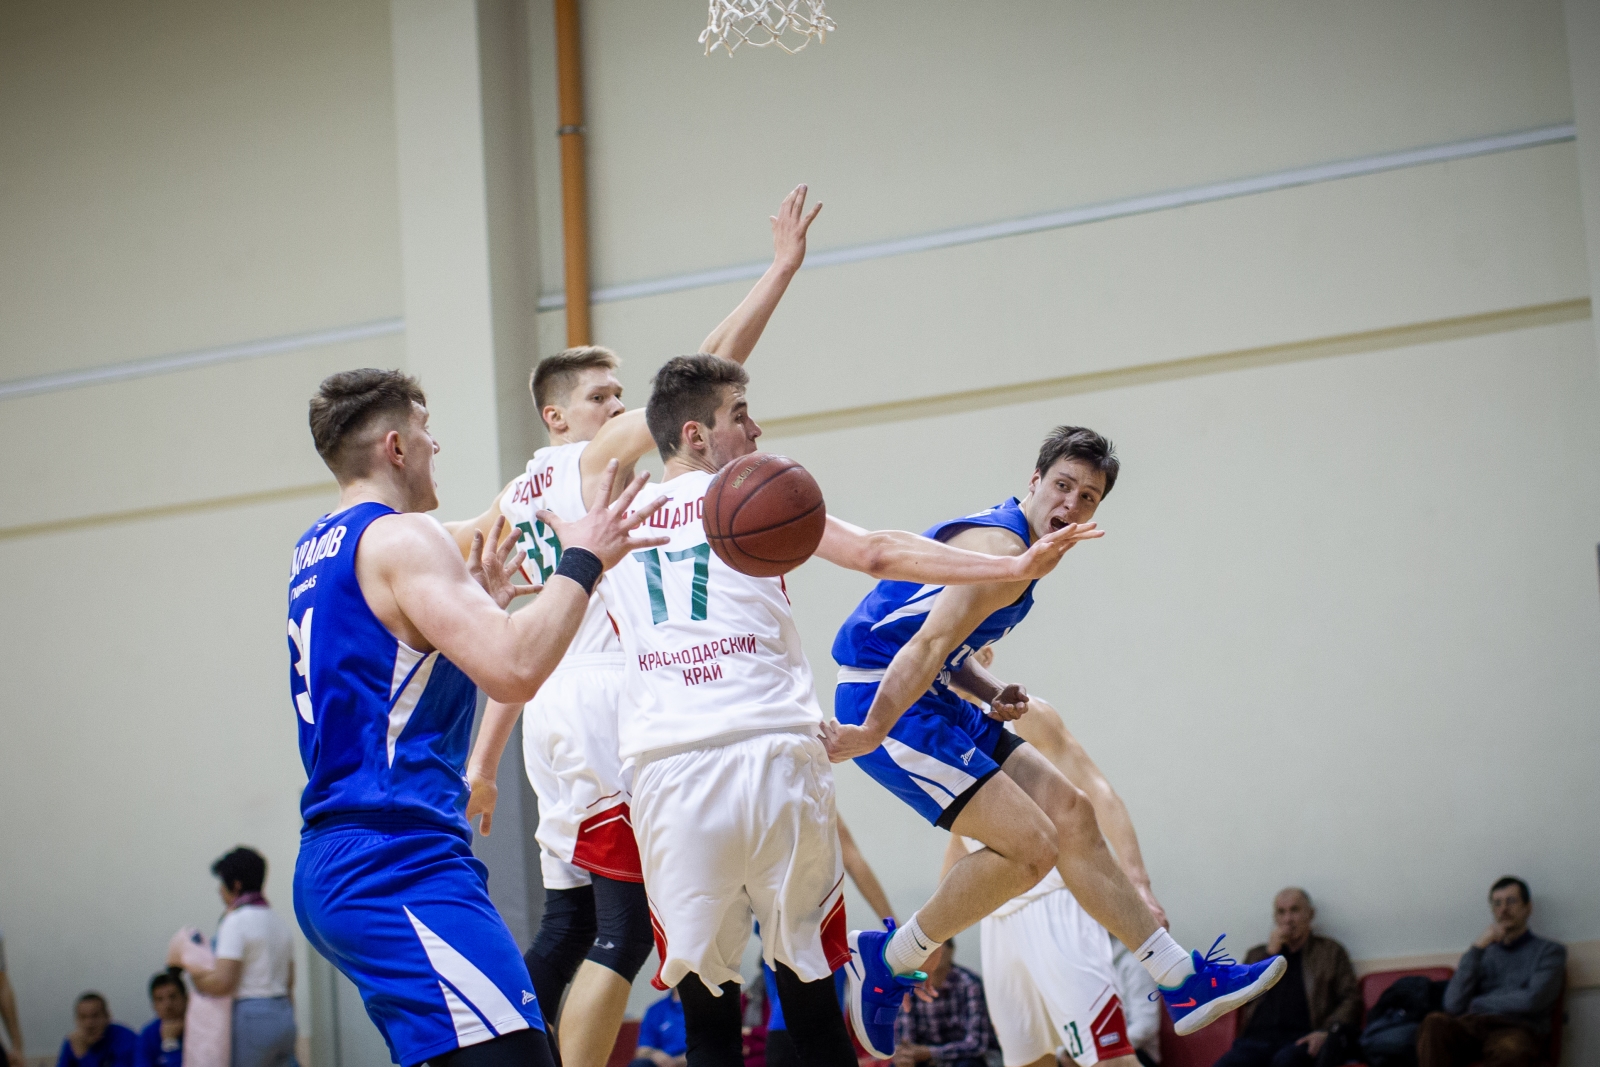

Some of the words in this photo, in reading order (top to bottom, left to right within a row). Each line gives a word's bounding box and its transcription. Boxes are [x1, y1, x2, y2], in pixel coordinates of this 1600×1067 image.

[632, 542, 711, 626] 17
[638, 633, 757, 672] КРАСНОДАРСКИЙ
[682, 661, 723, 687] КРАЙ
